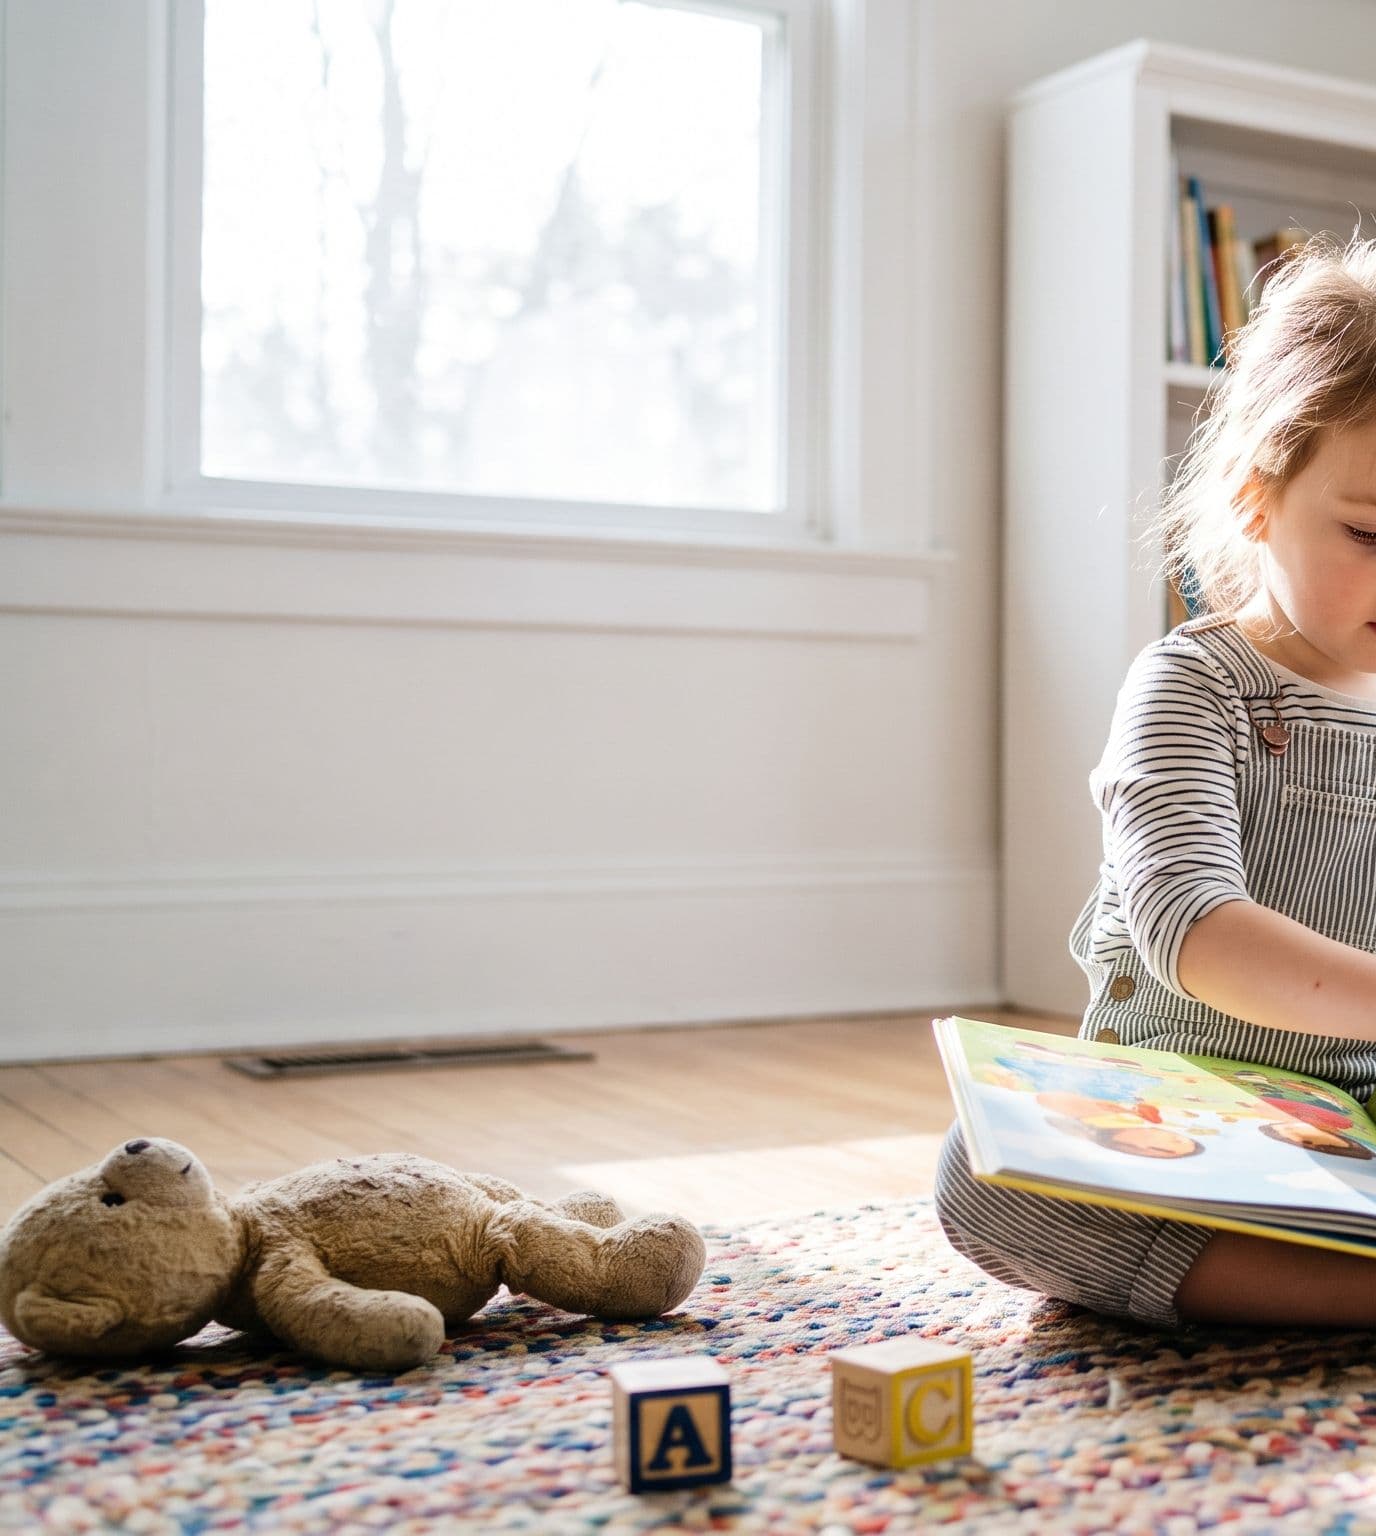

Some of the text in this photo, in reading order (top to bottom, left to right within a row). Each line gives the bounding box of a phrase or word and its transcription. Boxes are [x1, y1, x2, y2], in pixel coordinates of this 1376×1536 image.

[648, 1403, 713, 1471] A
[838, 1378, 882, 1443] B
[906, 1378, 955, 1446] C
